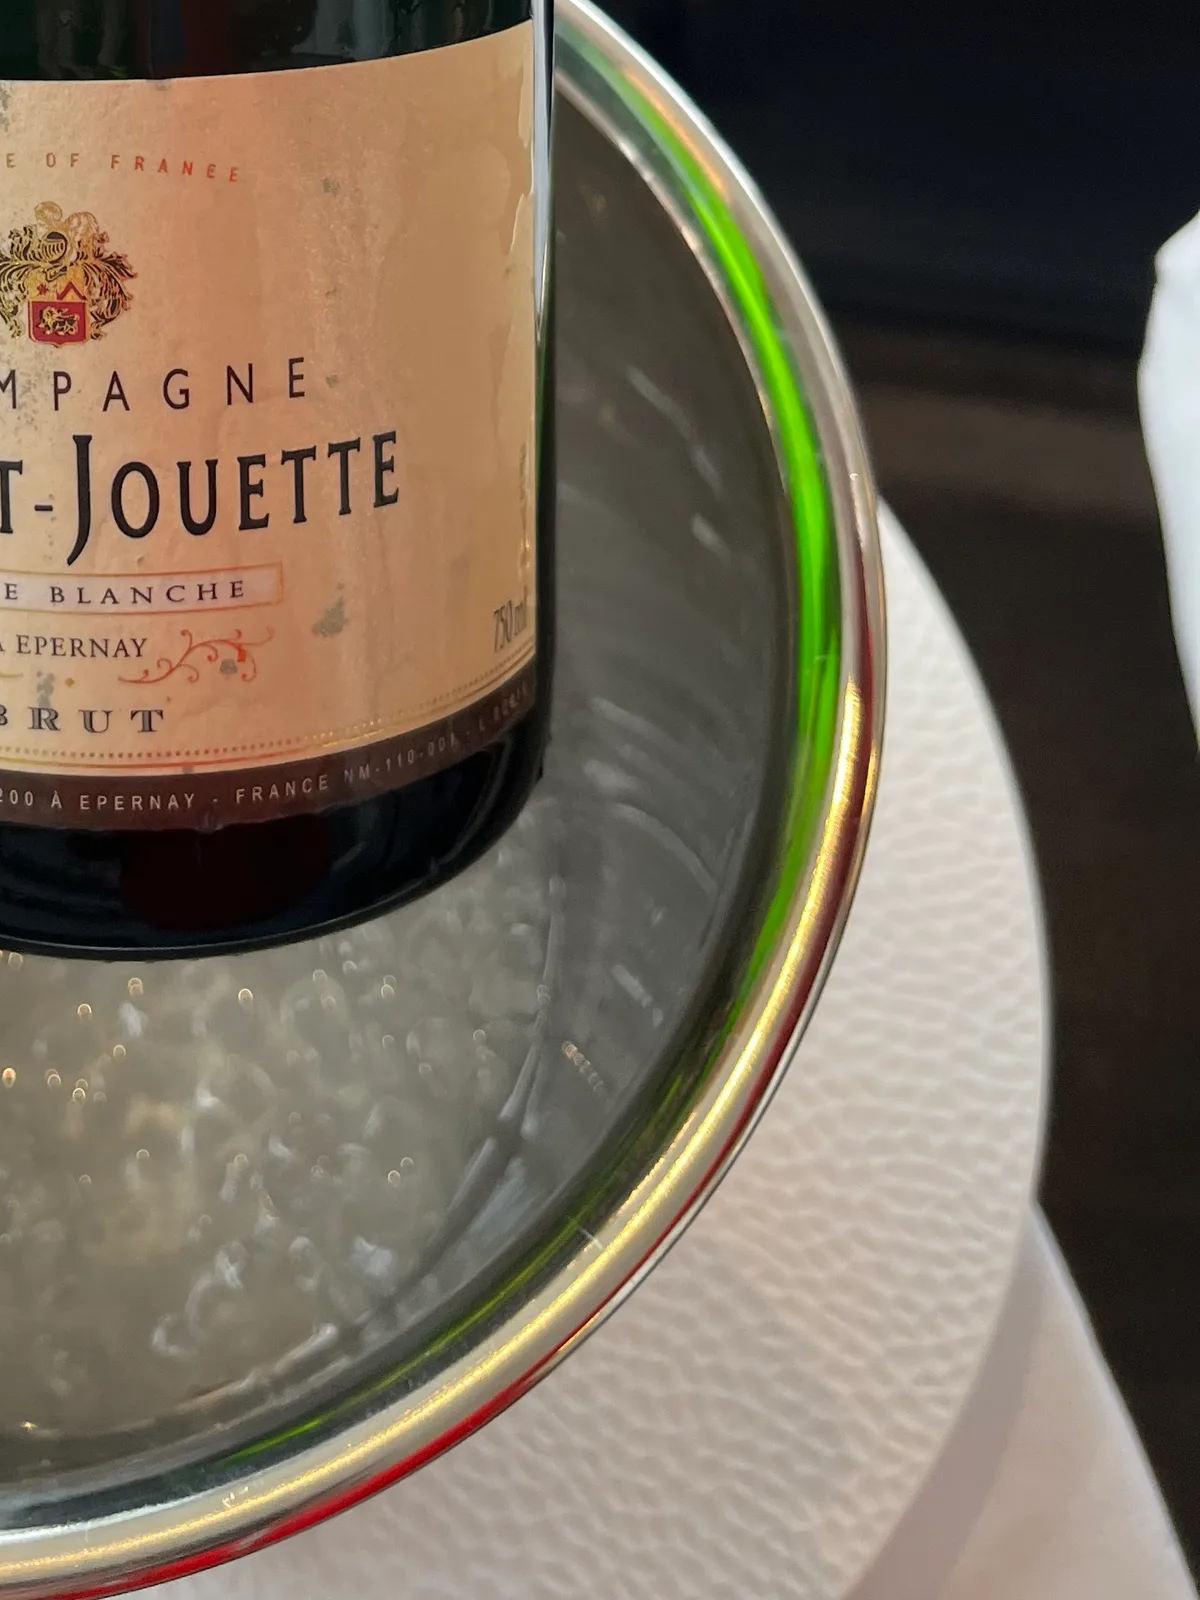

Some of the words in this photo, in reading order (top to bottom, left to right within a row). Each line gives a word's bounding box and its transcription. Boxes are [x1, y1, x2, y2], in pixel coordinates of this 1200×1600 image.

[45, 152, 80, 168] OF
[49, 578, 247, 606] BLANCHE
[16, 634, 150, 660] EPERNAY
[80, 792, 195, 811] EPERNAY
[236, 773, 329, 805] FRANCE
